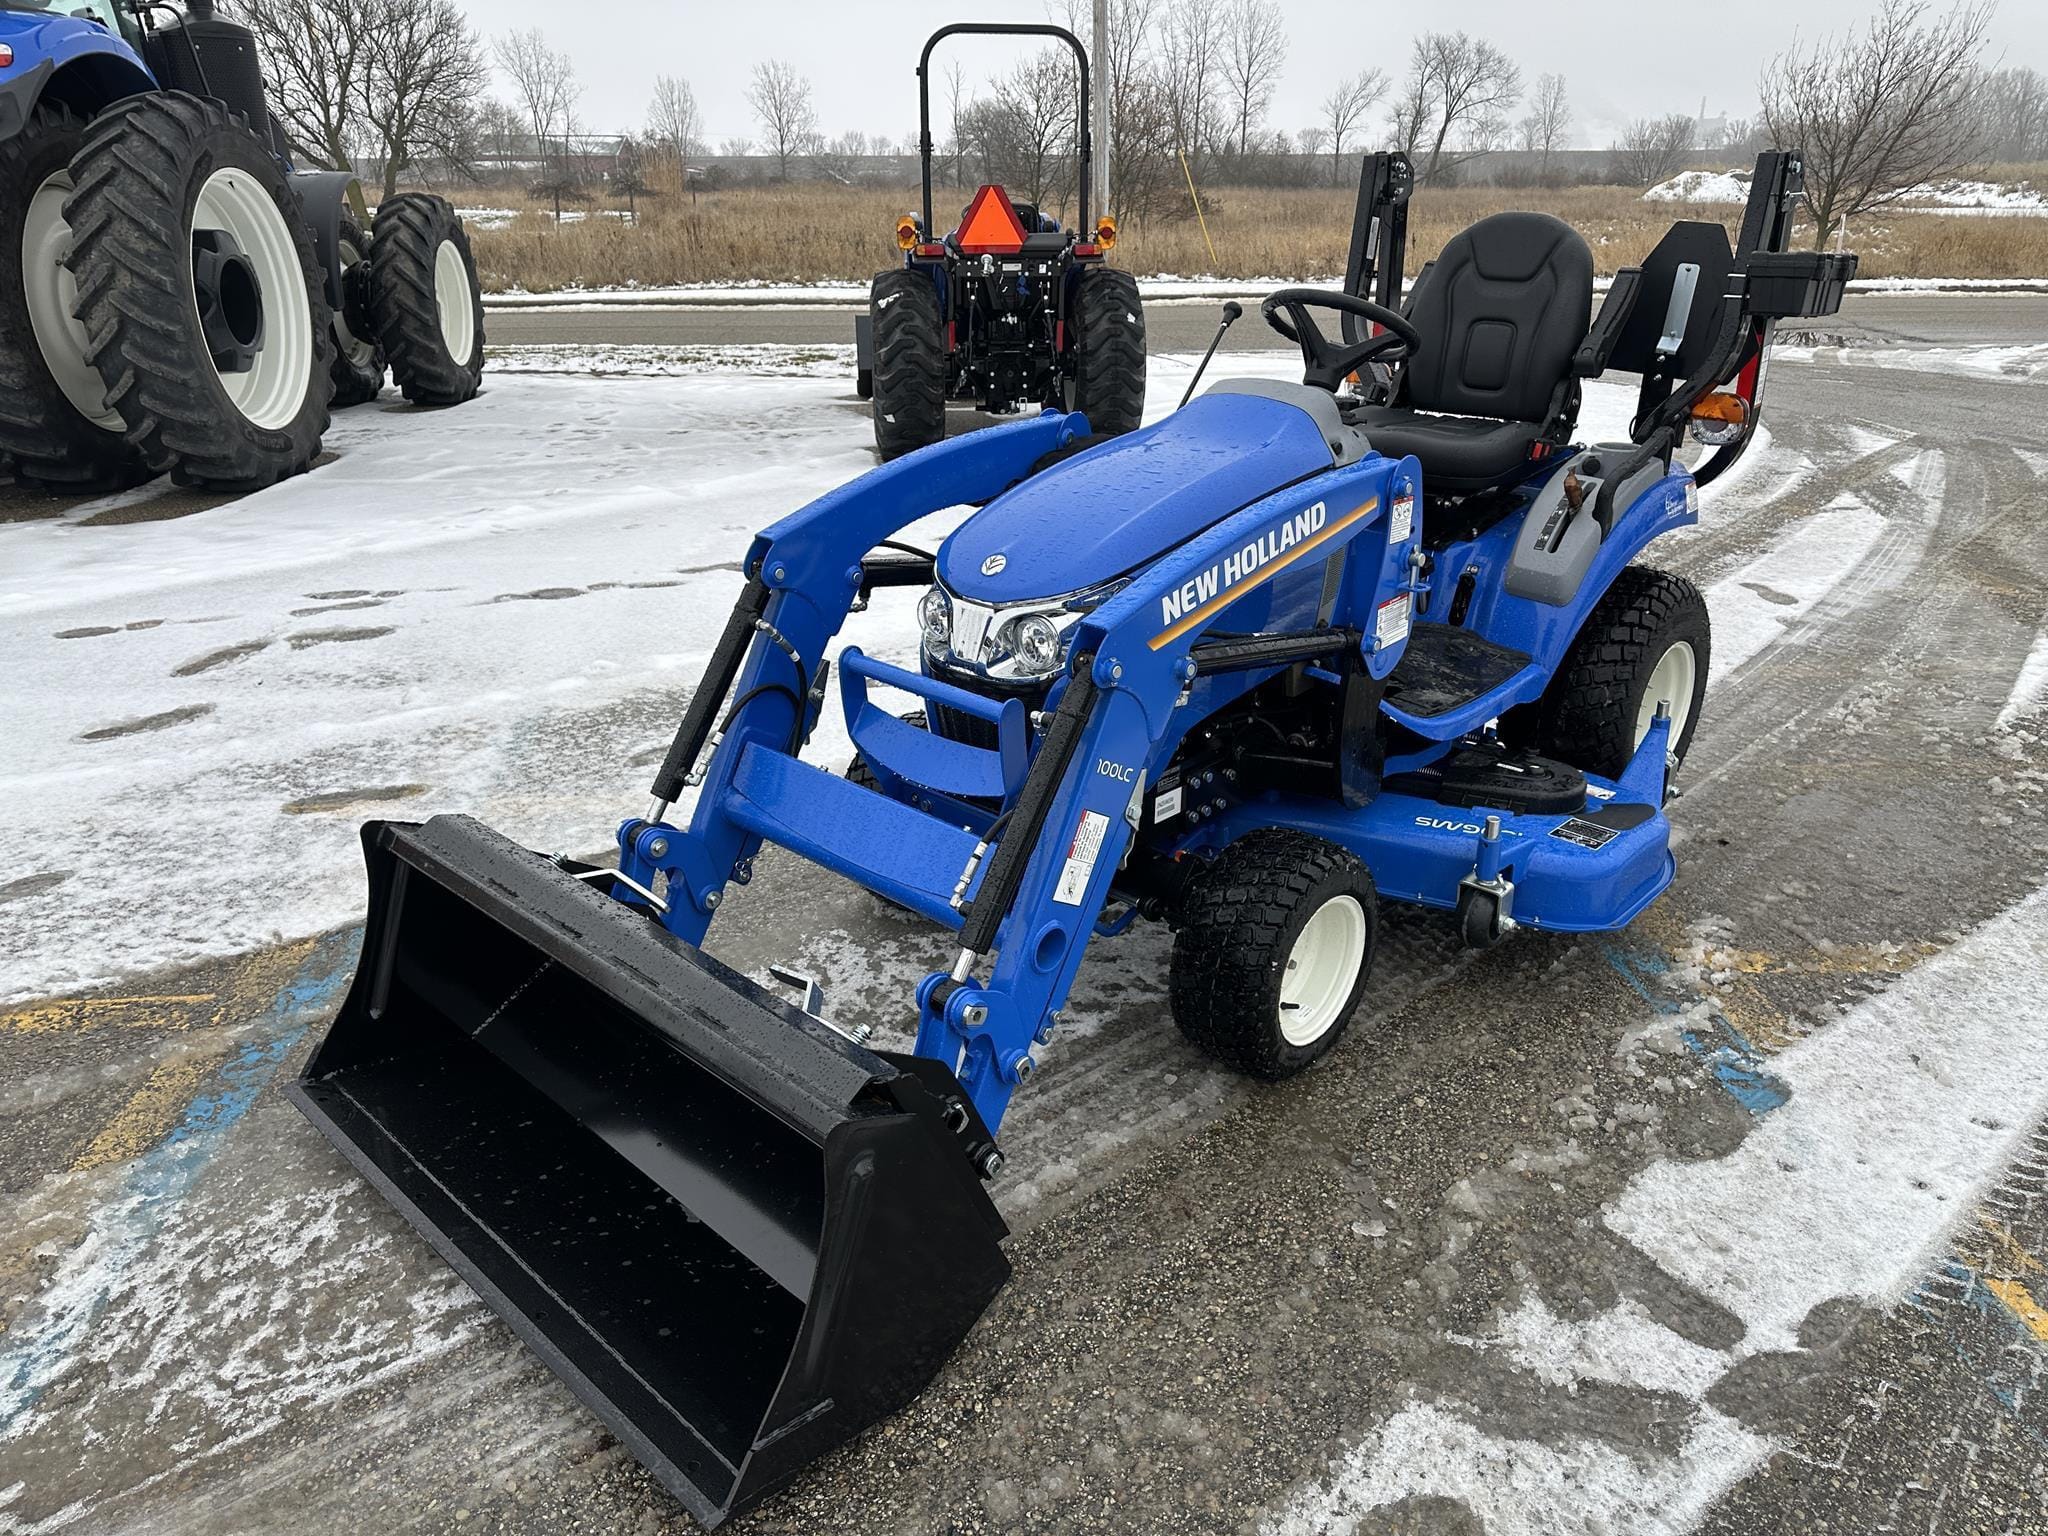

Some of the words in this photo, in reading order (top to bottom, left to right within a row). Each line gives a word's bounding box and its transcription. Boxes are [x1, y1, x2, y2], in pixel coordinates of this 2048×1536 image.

[1161, 565, 1219, 626] NEW
[1223, 501, 1327, 587] HOLLAND
[1097, 758, 1133, 782] 100LC
[1414, 816, 1524, 836] GMS
